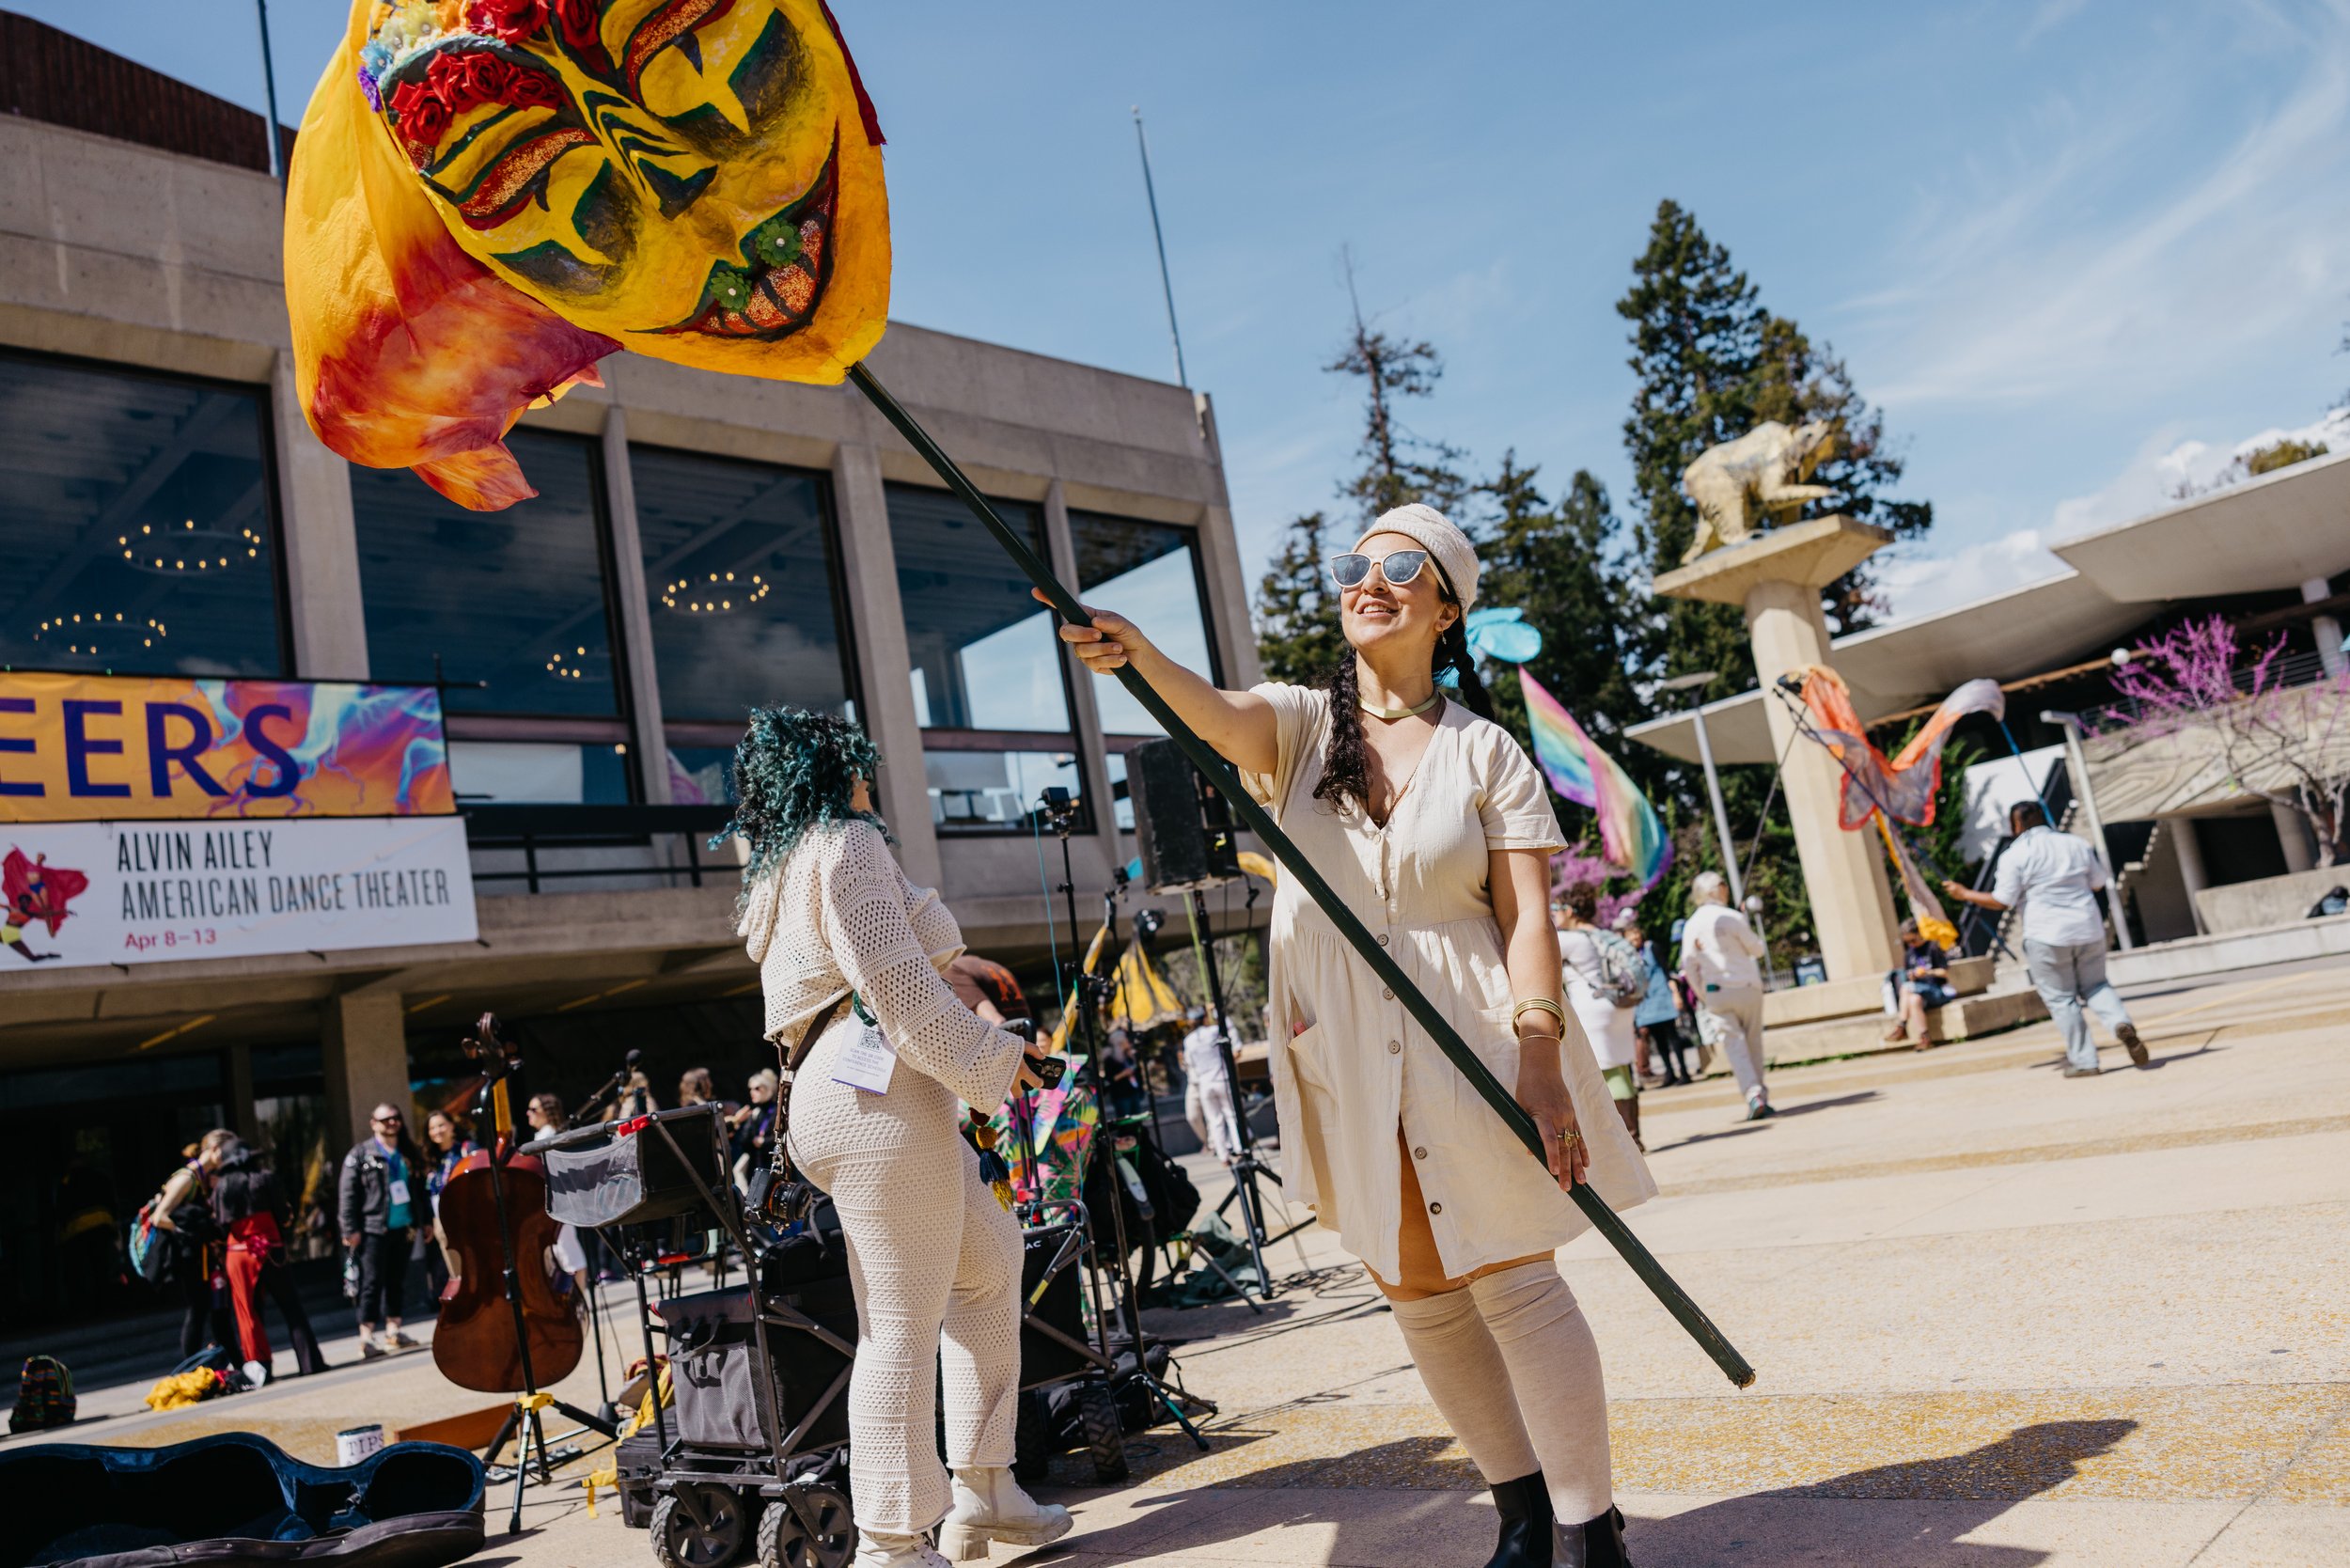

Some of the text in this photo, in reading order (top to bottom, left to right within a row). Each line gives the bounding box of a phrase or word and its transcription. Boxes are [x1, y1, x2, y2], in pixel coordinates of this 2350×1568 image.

[0, 698, 301, 798] EERS
[118, 830, 272, 871] ALVIN AILEY
[122, 869, 450, 920] AMERICAN DANCE THEATER
[125, 933, 157, 952] Apr
